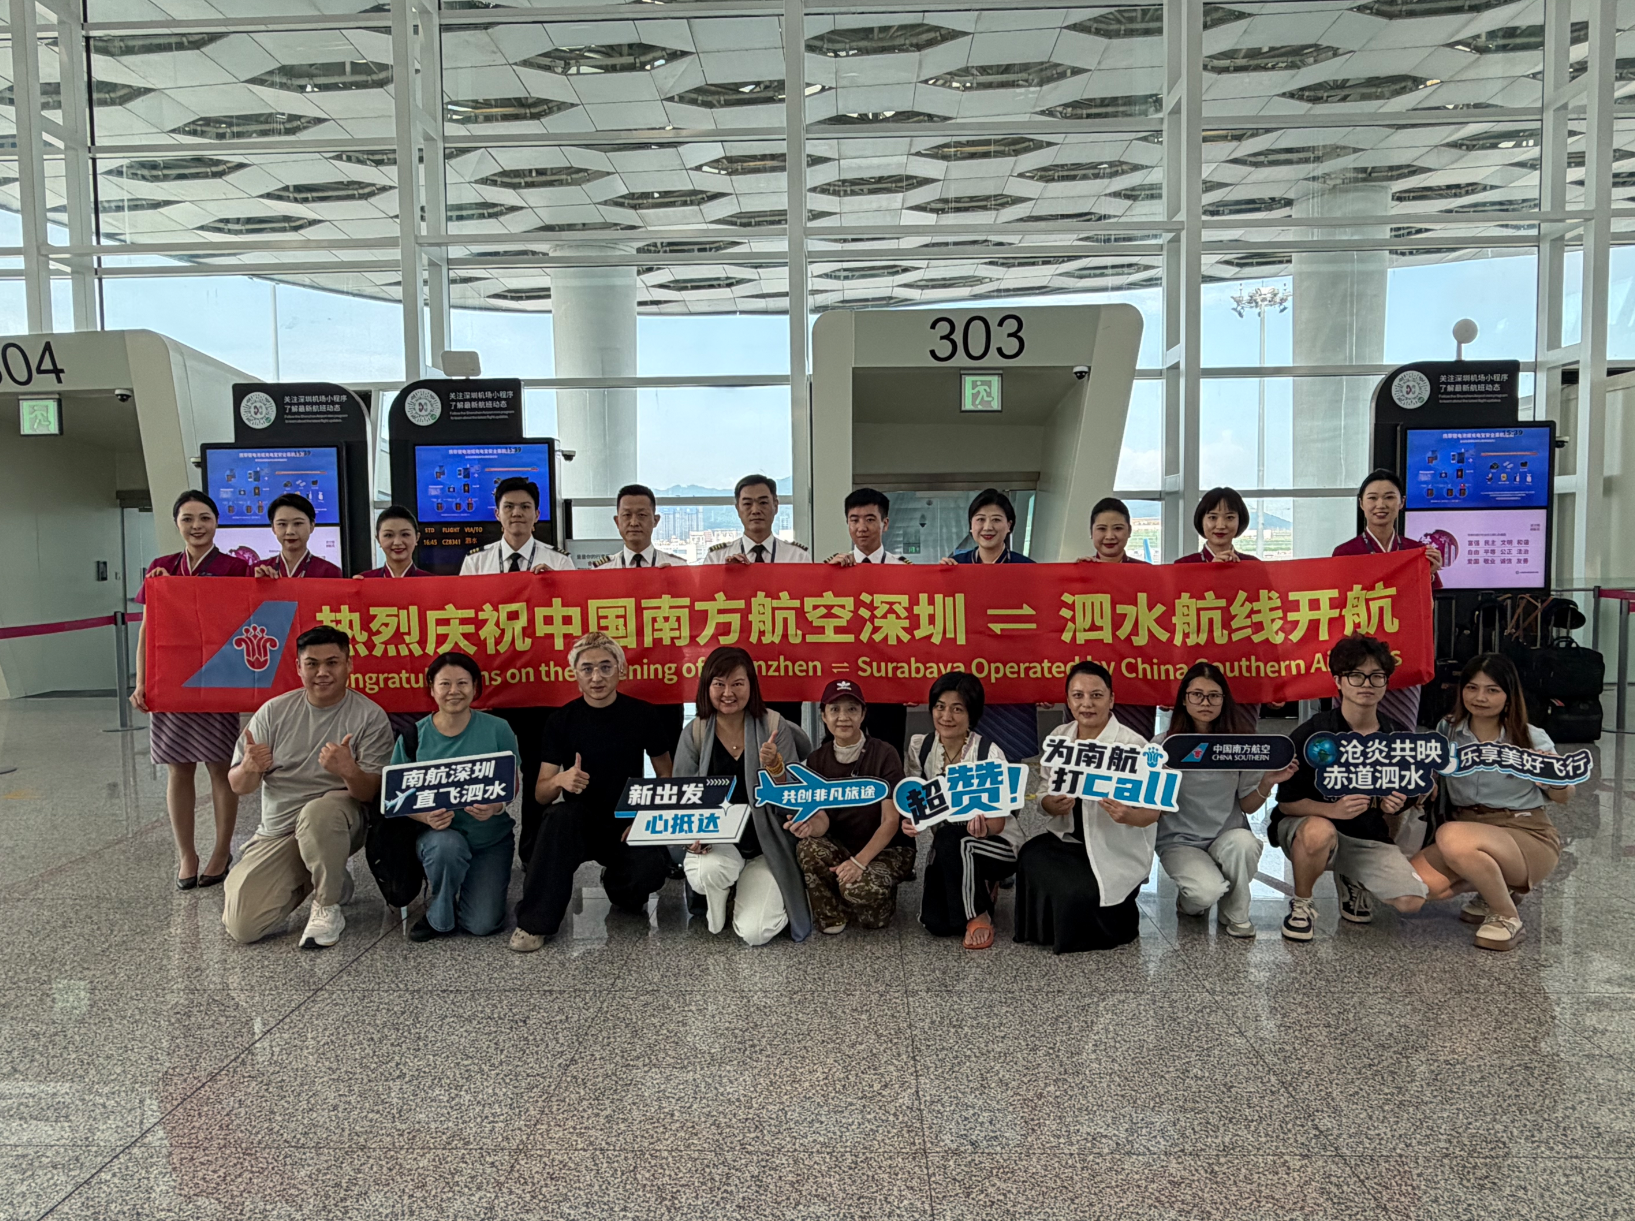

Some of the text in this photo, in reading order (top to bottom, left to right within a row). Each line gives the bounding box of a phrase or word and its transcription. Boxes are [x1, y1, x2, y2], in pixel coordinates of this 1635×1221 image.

[929, 314, 1025, 362] 303
[0, 341, 65, 386] 04
[1439, 373, 1509, 383] 关注深圳机场小程序
[1439, 383, 1501, 392] 了解最新航班动态
[283, 395, 348, 404] 关注深圳机场小程序
[449, 391, 514, 400] 关注深圳机场小程序
[449, 400, 508, 410] 了解最新航班动态
[283, 404, 341, 413] 了解最新航班动态
[315, 581, 1400, 658] 热烈庆祝中国南方航空深圳 泗水航线开航
[506, 667, 535, 684] on
[539, 660, 577, 682] the
[619, 658, 678, 685] ning
[682, 656, 706, 678] of
[753, 655, 822, 677] nzhen
[1121, 657, 1188, 680] China
[1195, 655, 1306, 678] outhern
[1044, 738, 1141, 775] 为南航
[1212, 744, 1271, 754] 中国南方航空
[1338, 738, 1443, 764] 沧炎共映
[1460, 745, 1588, 777] 乐享美好飞行
[401, 760, 496, 789] 南航深圳
[1322, 764, 1426, 790] 赤道泗水
[412, 780, 507, 810] 直飞泗水
[627, 783, 705, 806] 新出发
[781, 785, 876, 804] 共创非凡旅途
[644, 812, 721, 835] 心抵达
